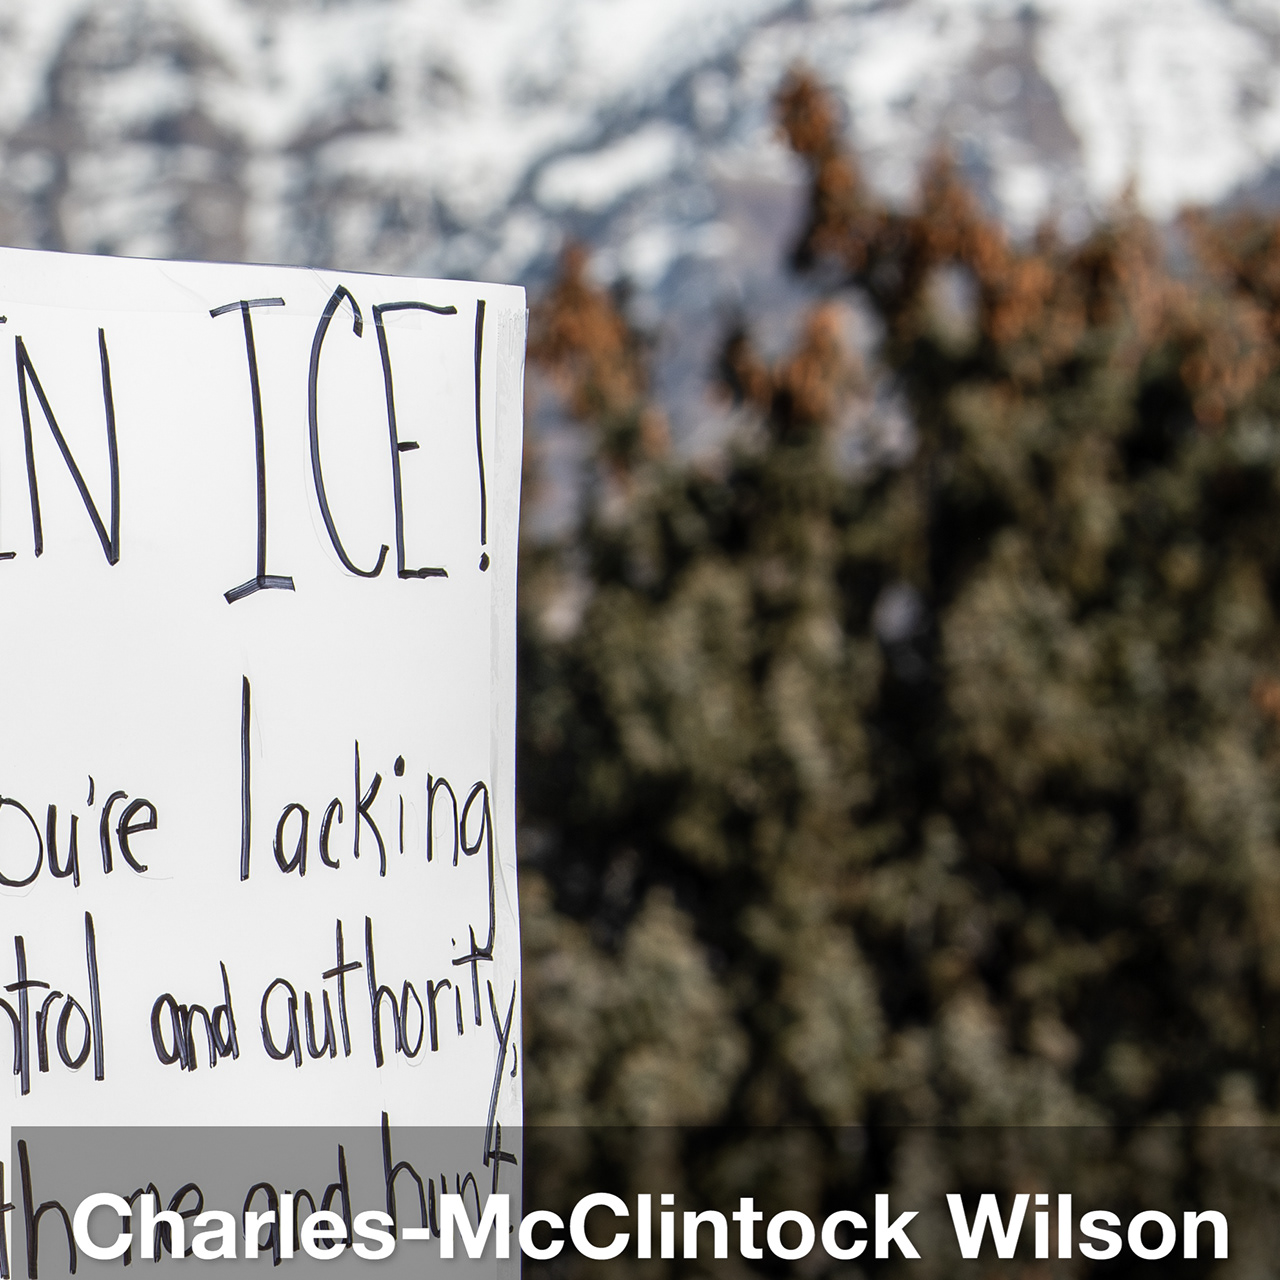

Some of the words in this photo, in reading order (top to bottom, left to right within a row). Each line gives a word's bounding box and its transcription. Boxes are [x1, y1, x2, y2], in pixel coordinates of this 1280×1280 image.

[208, 285, 491, 604] ICE!
[238, 674, 497, 957] lacking
[150, 961, 239, 1072] and
[260, 915, 518, 1165] authority,
[242, 1143, 353, 1267] and
